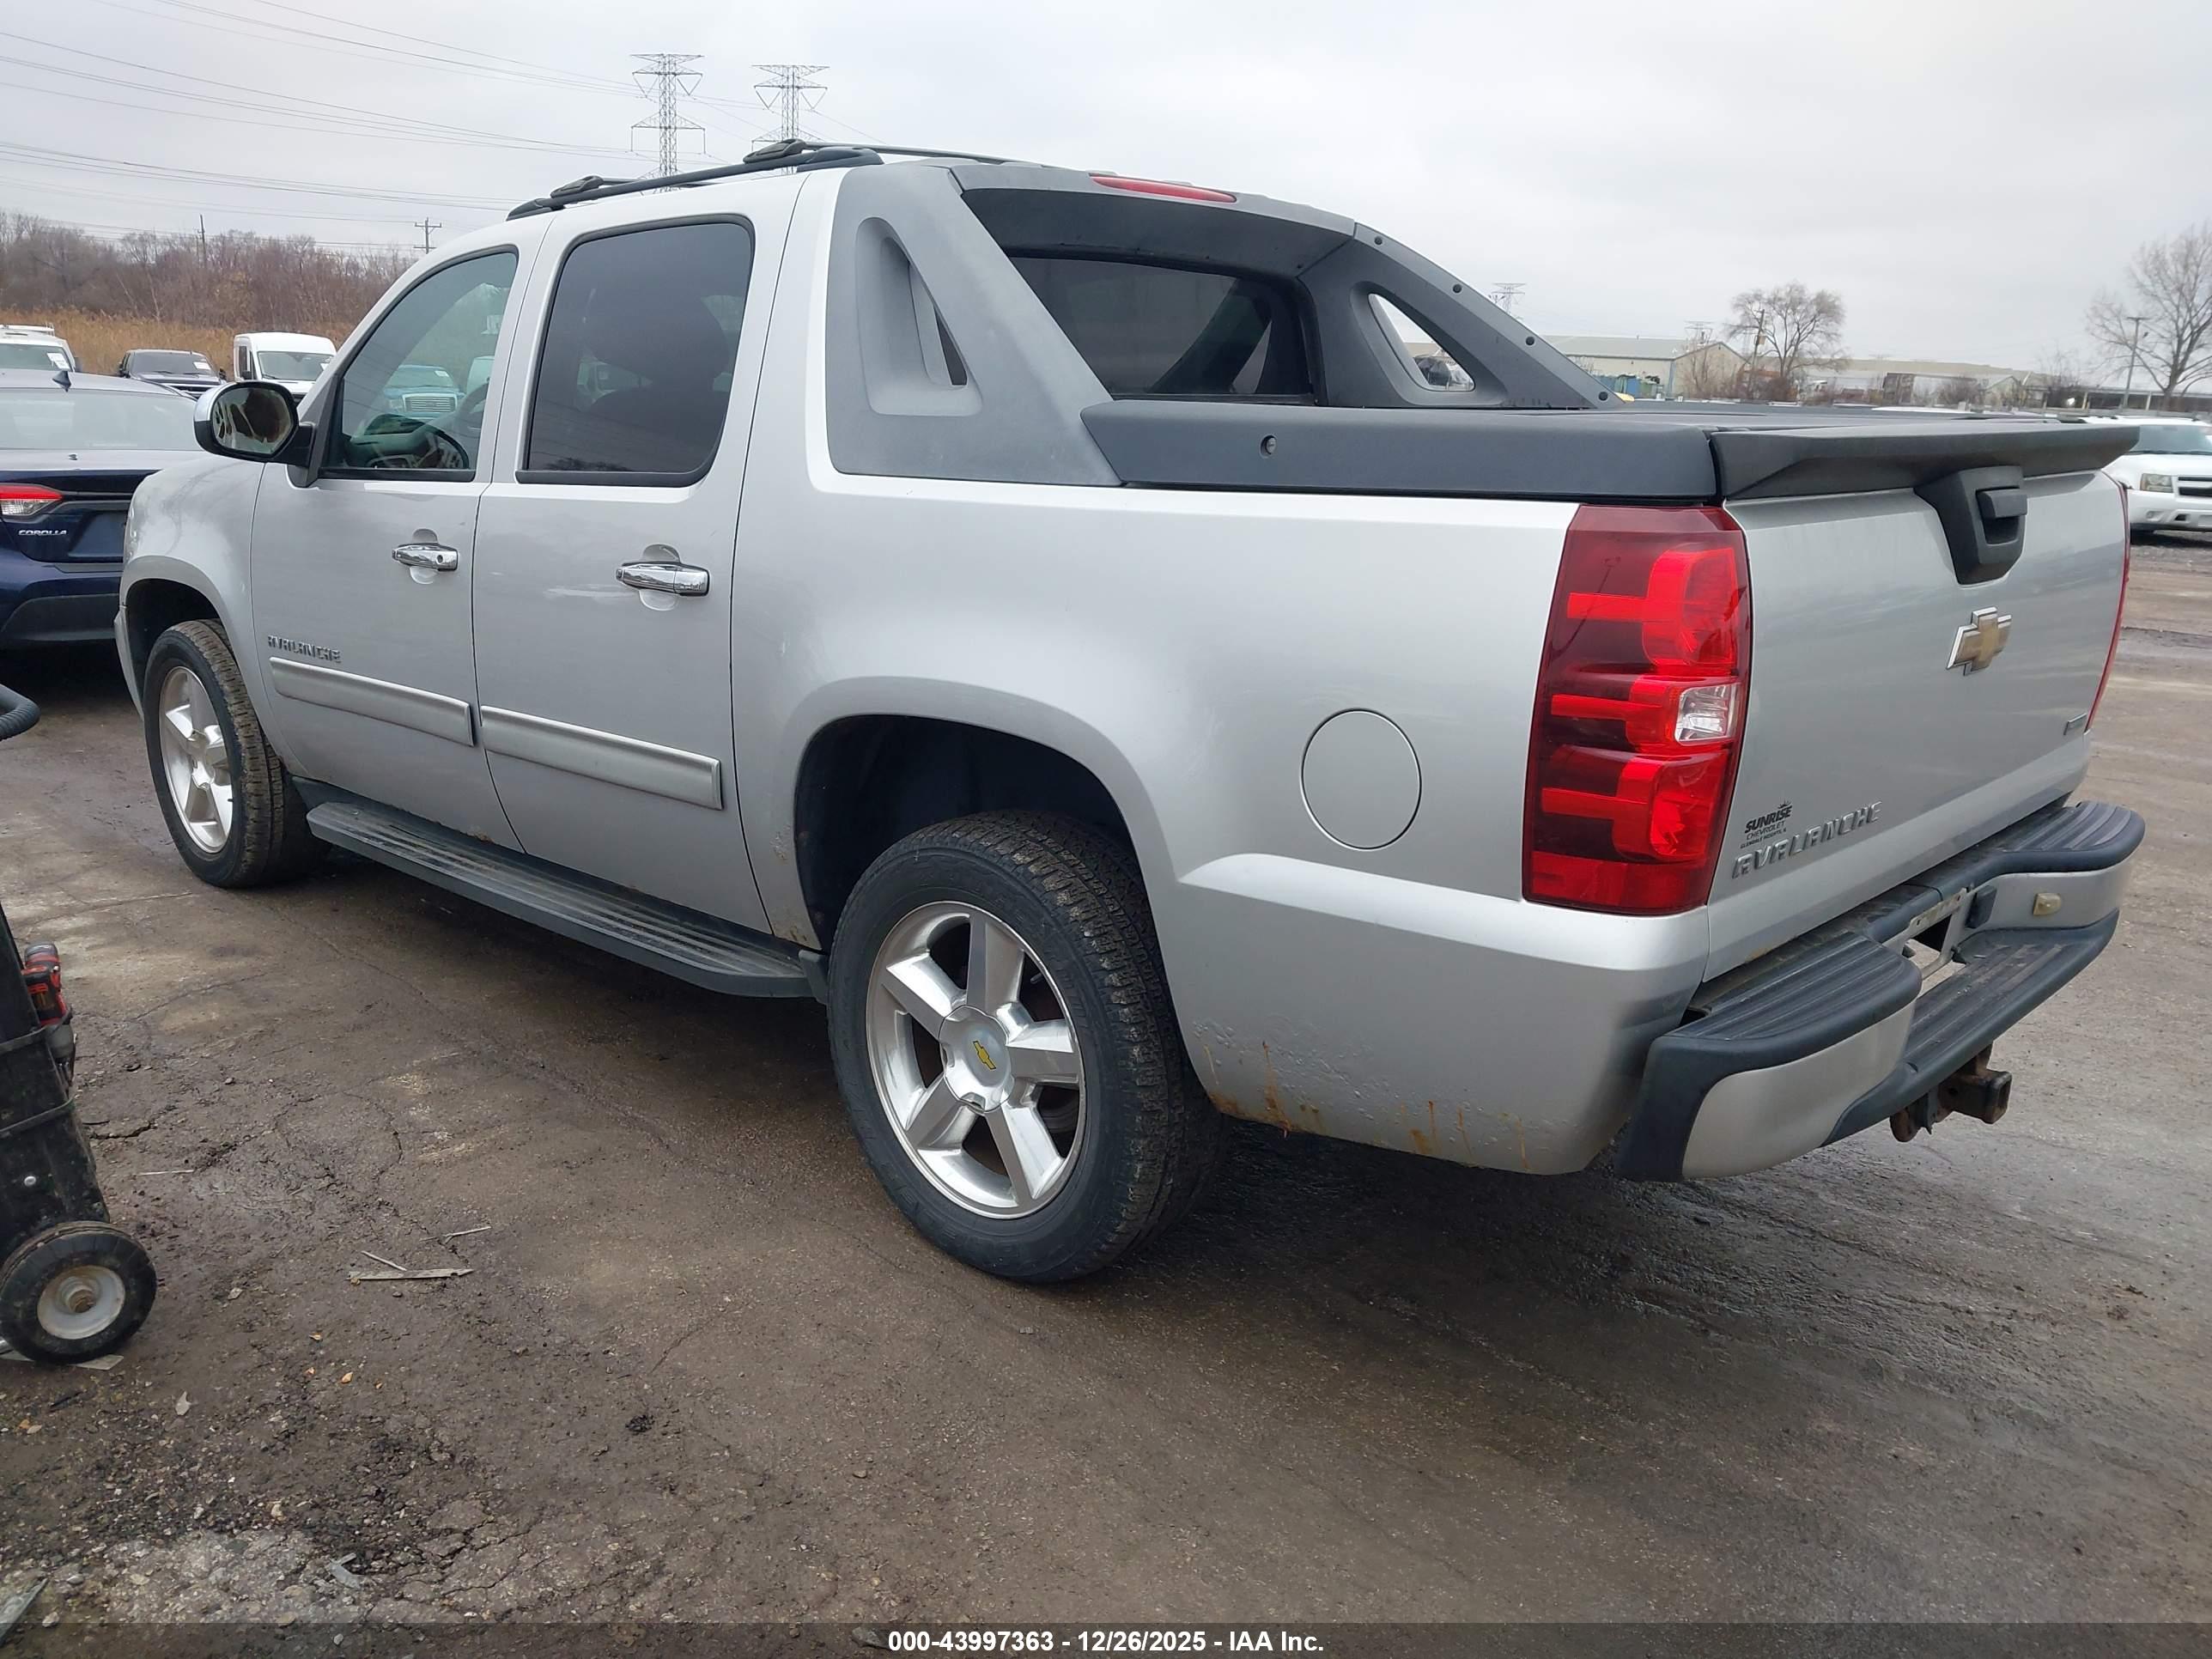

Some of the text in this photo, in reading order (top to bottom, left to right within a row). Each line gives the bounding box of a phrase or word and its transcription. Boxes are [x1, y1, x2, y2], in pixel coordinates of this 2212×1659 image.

[18, 529, 67, 538] COROLLA
[267, 635, 342, 663] AVALANCHE
[1745, 805, 1792, 833] SUNRISE
[1747, 820, 1784, 840] CHEVROLET
[1732, 801, 1882, 879] AVALANCHE
